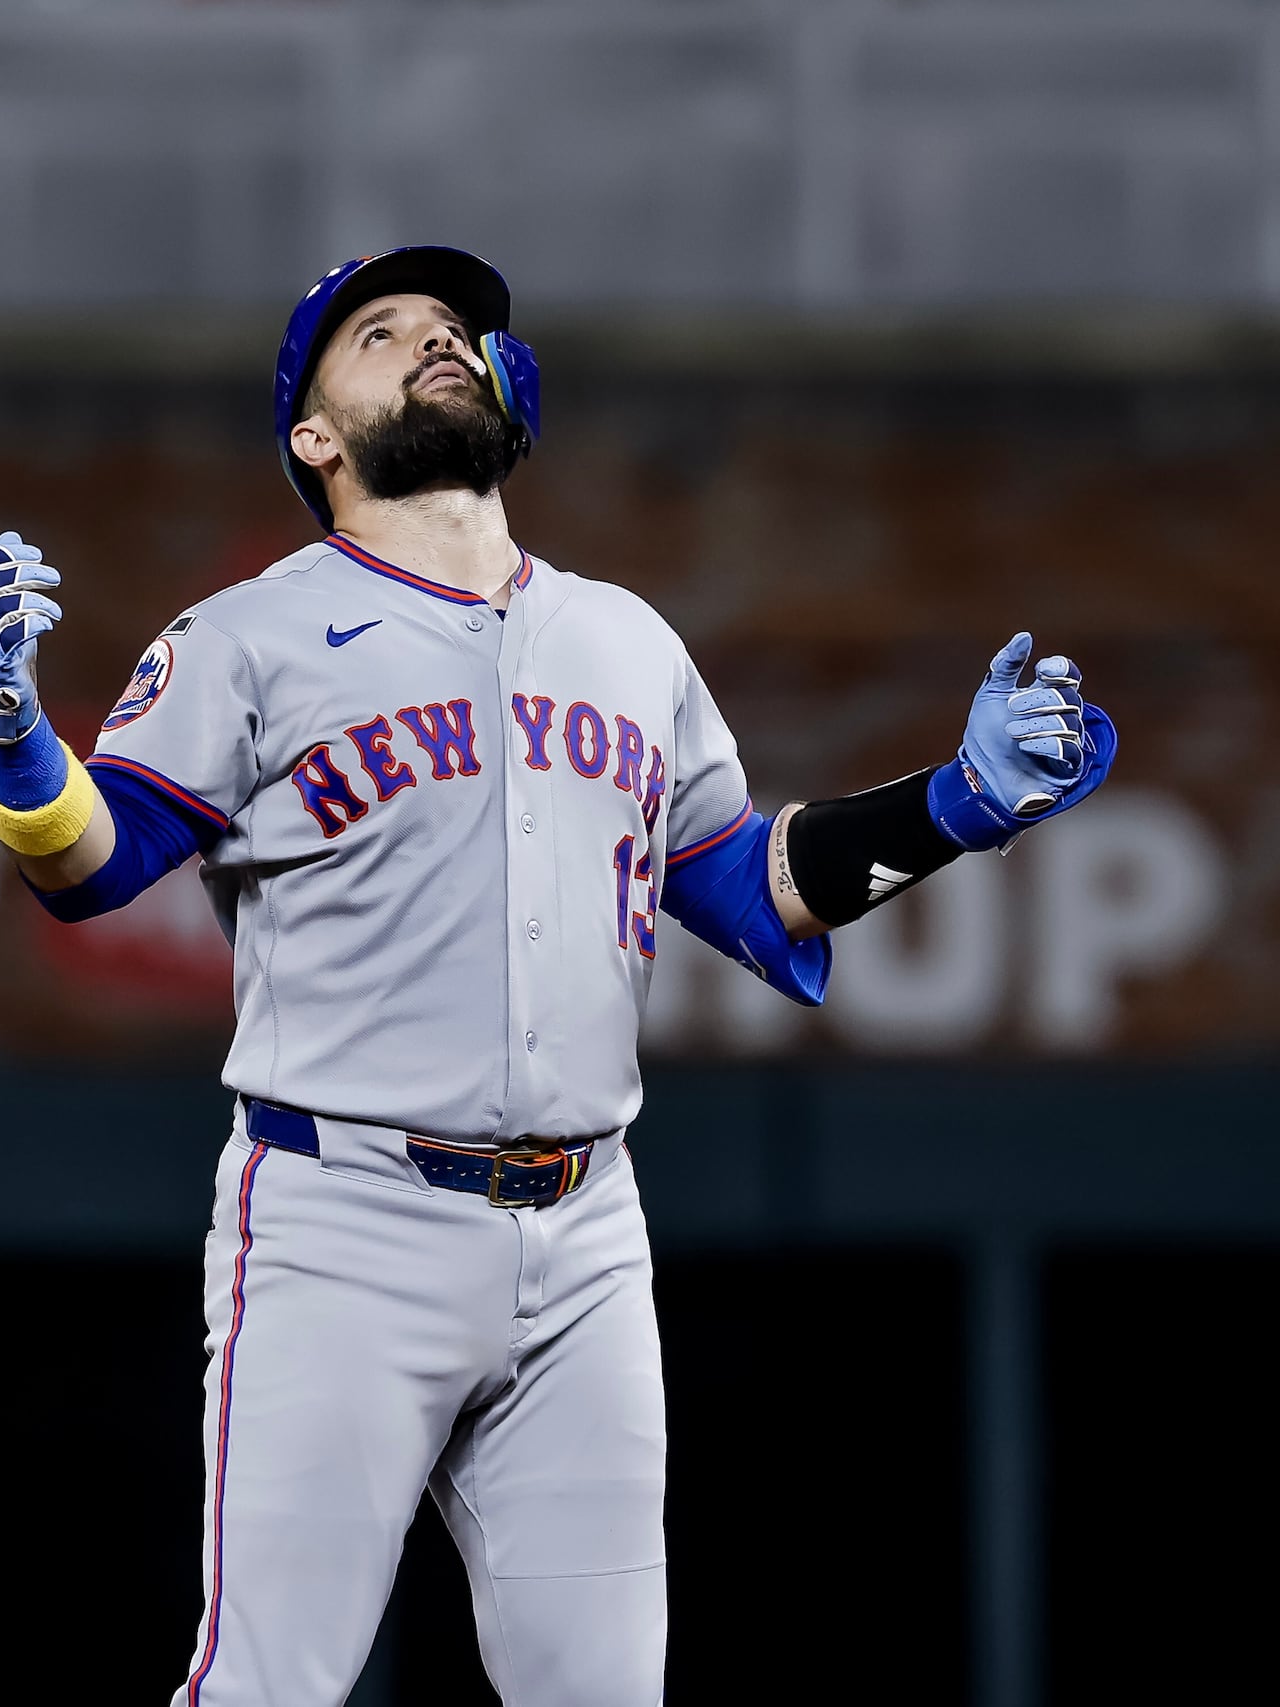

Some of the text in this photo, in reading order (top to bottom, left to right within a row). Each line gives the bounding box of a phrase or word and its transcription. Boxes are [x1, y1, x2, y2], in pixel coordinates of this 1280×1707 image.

[291, 693, 666, 839] NEW YORK
[613, 833, 657, 960] 13
